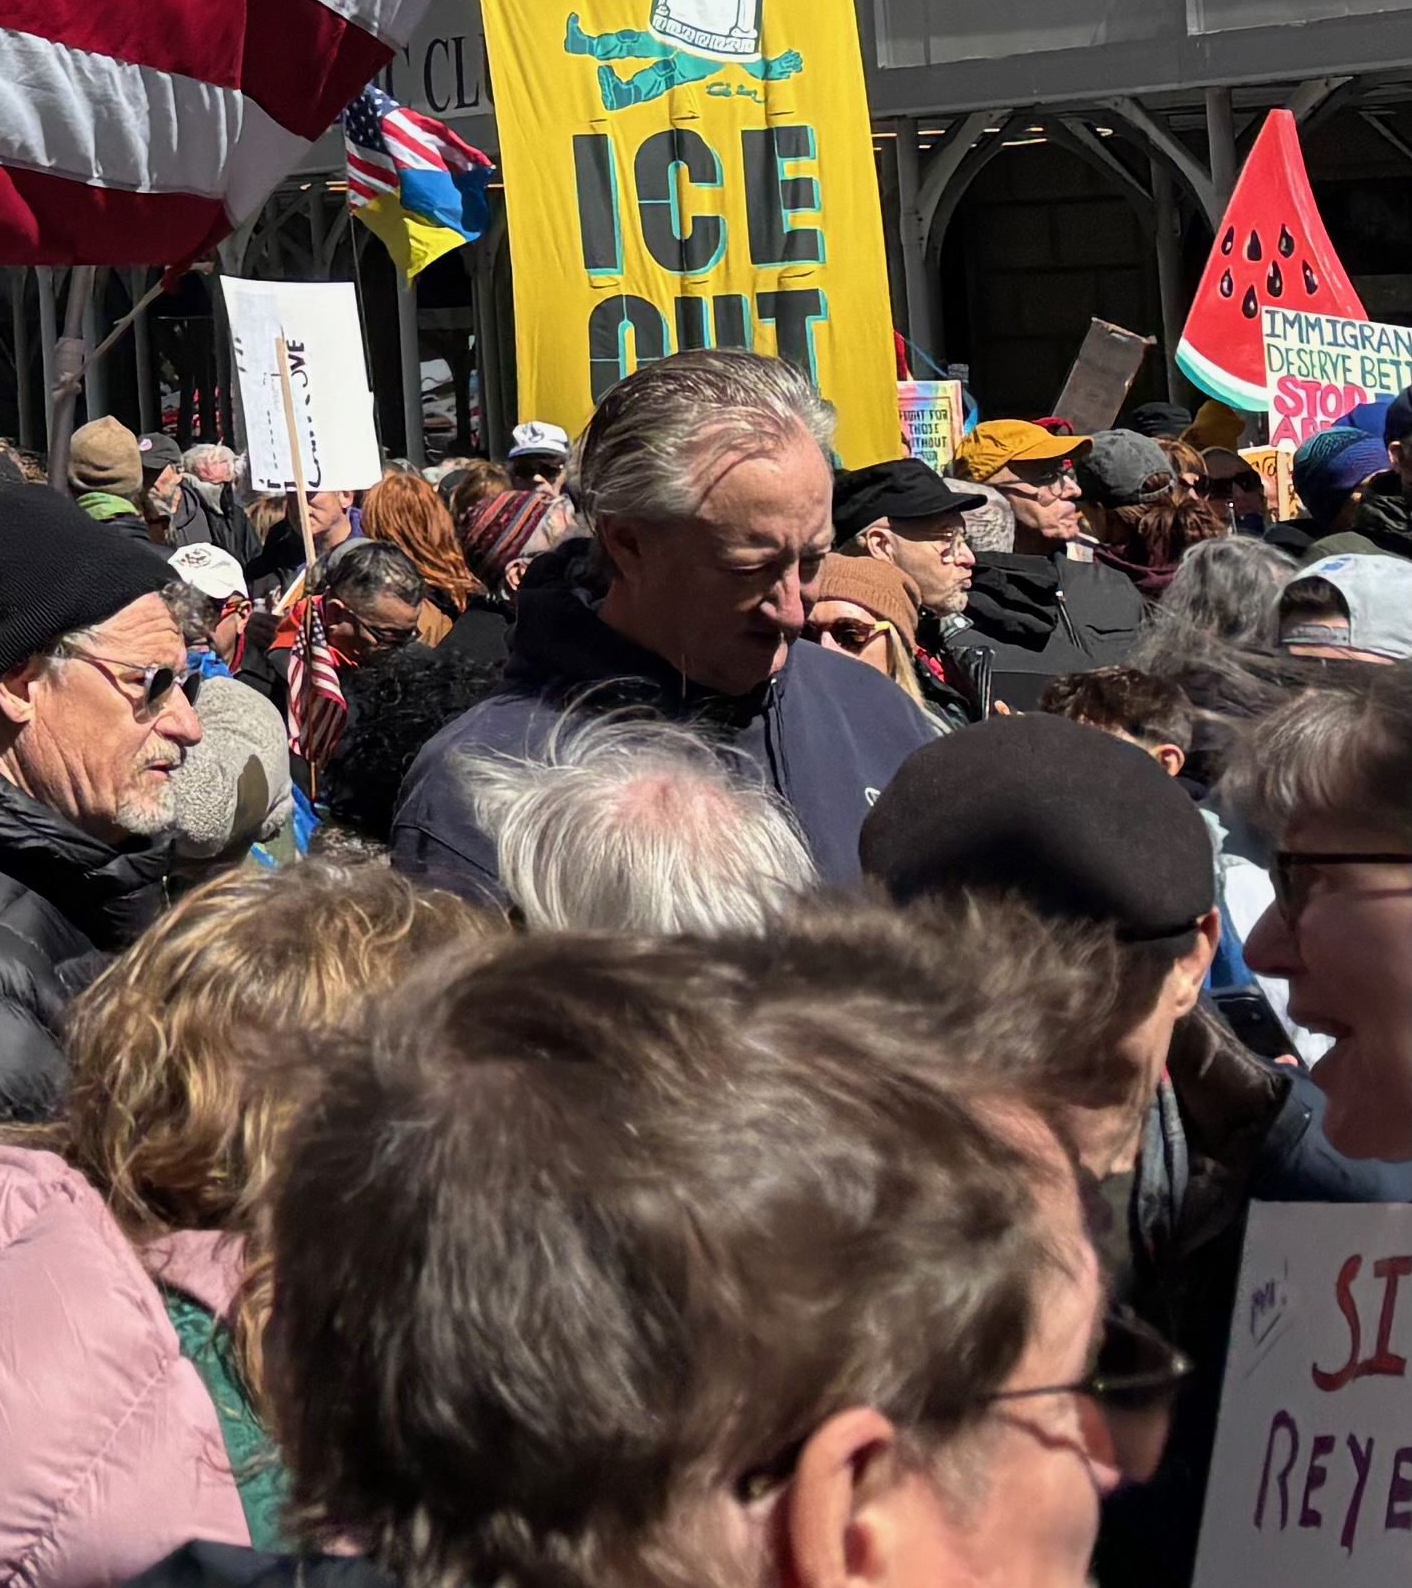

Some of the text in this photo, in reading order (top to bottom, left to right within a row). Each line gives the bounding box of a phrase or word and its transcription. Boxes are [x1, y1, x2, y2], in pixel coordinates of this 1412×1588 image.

[424, 35, 494, 113] CL
[572, 125, 826, 277] ICE
[1266, 342, 1352, 385] DESERVE
[909, 423, 940, 435] THOSE
